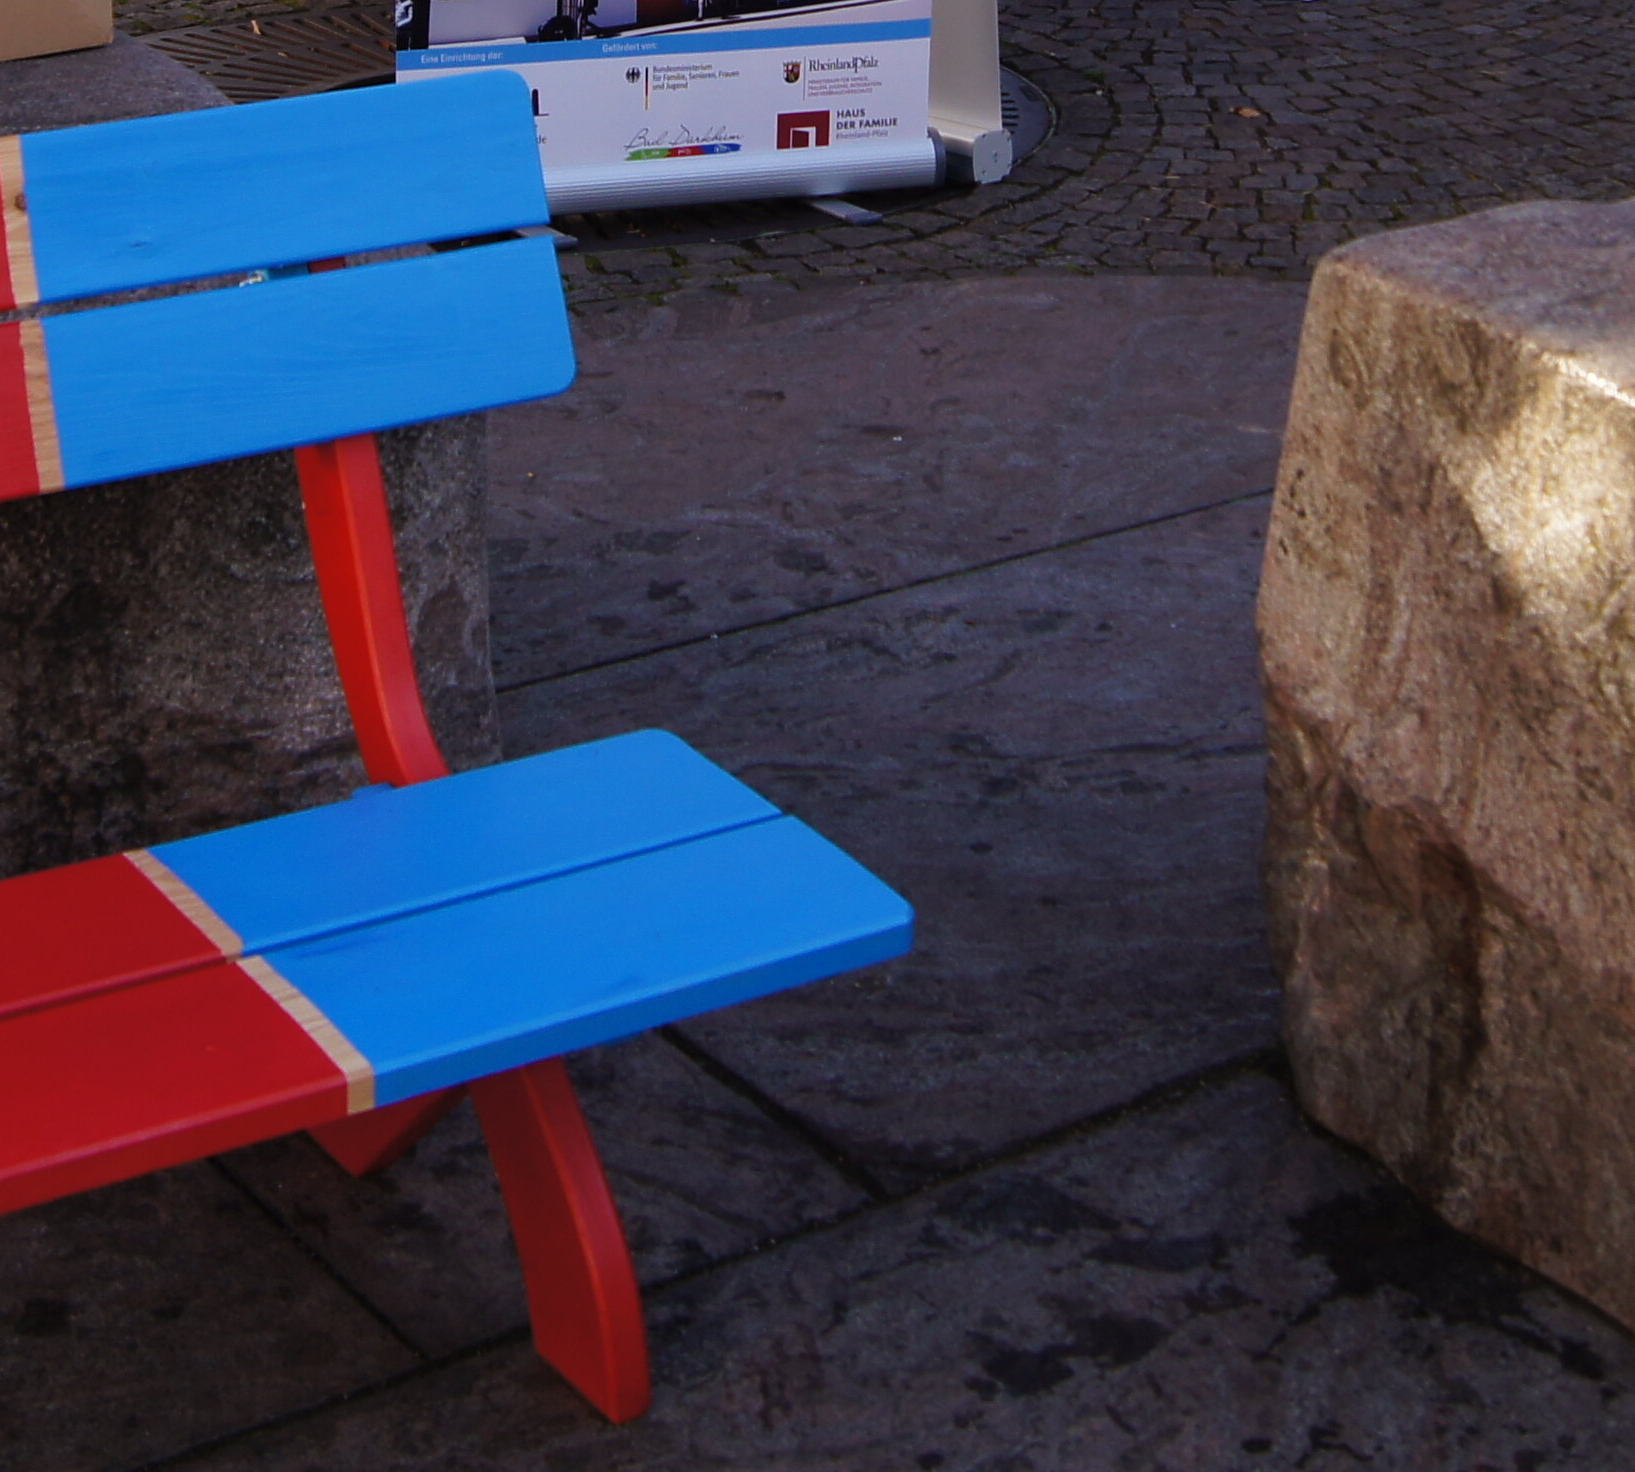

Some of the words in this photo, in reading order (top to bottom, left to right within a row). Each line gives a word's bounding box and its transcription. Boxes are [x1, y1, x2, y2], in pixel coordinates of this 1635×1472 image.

[837, 108, 866, 119] HAUS
[836, 120, 856, 130] DER
[859, 117, 898, 128] FAMILIE
